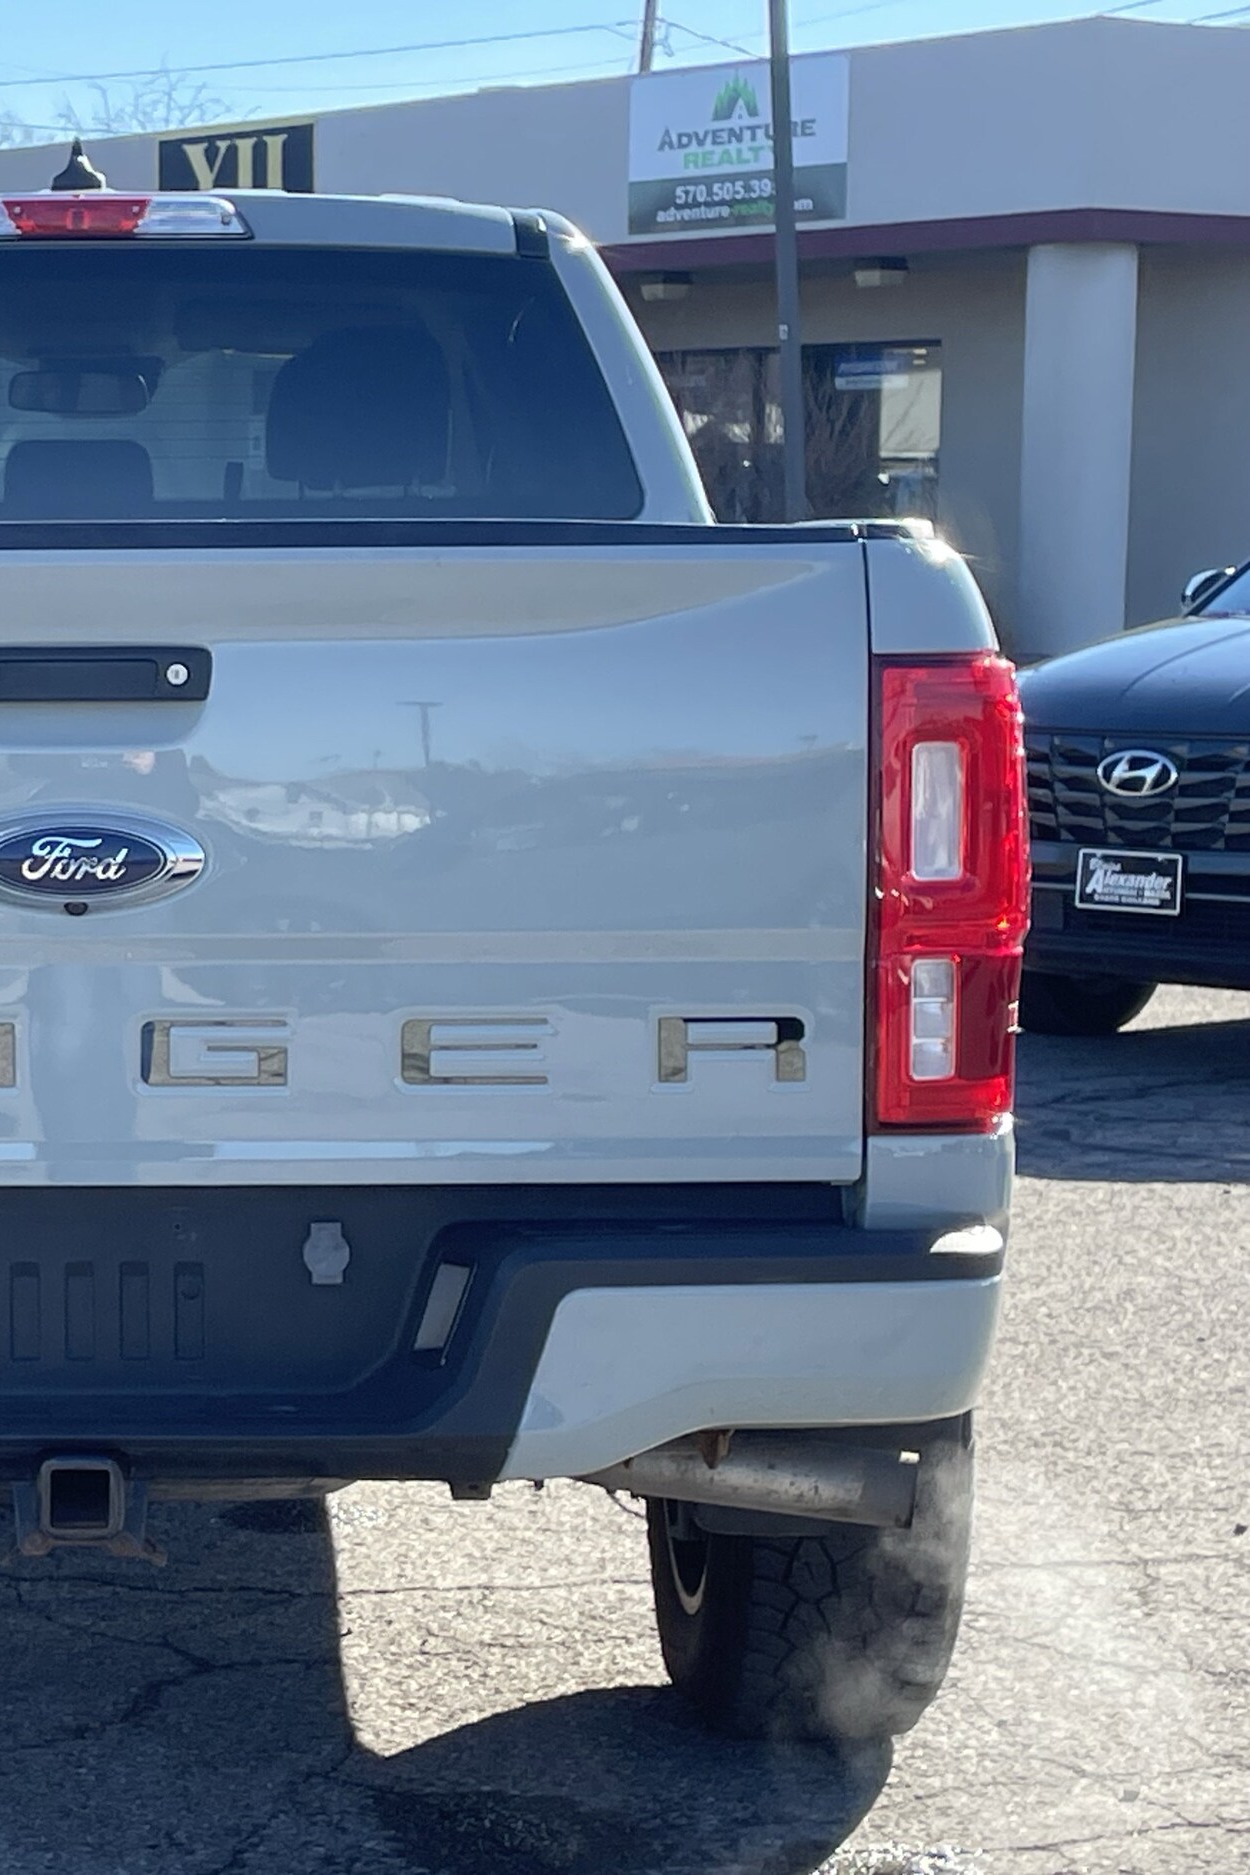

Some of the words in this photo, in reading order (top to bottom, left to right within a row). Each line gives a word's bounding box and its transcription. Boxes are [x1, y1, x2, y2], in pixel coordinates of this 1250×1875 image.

[182, 134, 288, 189] VII
[683, 145, 774, 170] REALT
[675, 179, 776, 204] 570.505.39
[21, 836, 129, 881] Ford
